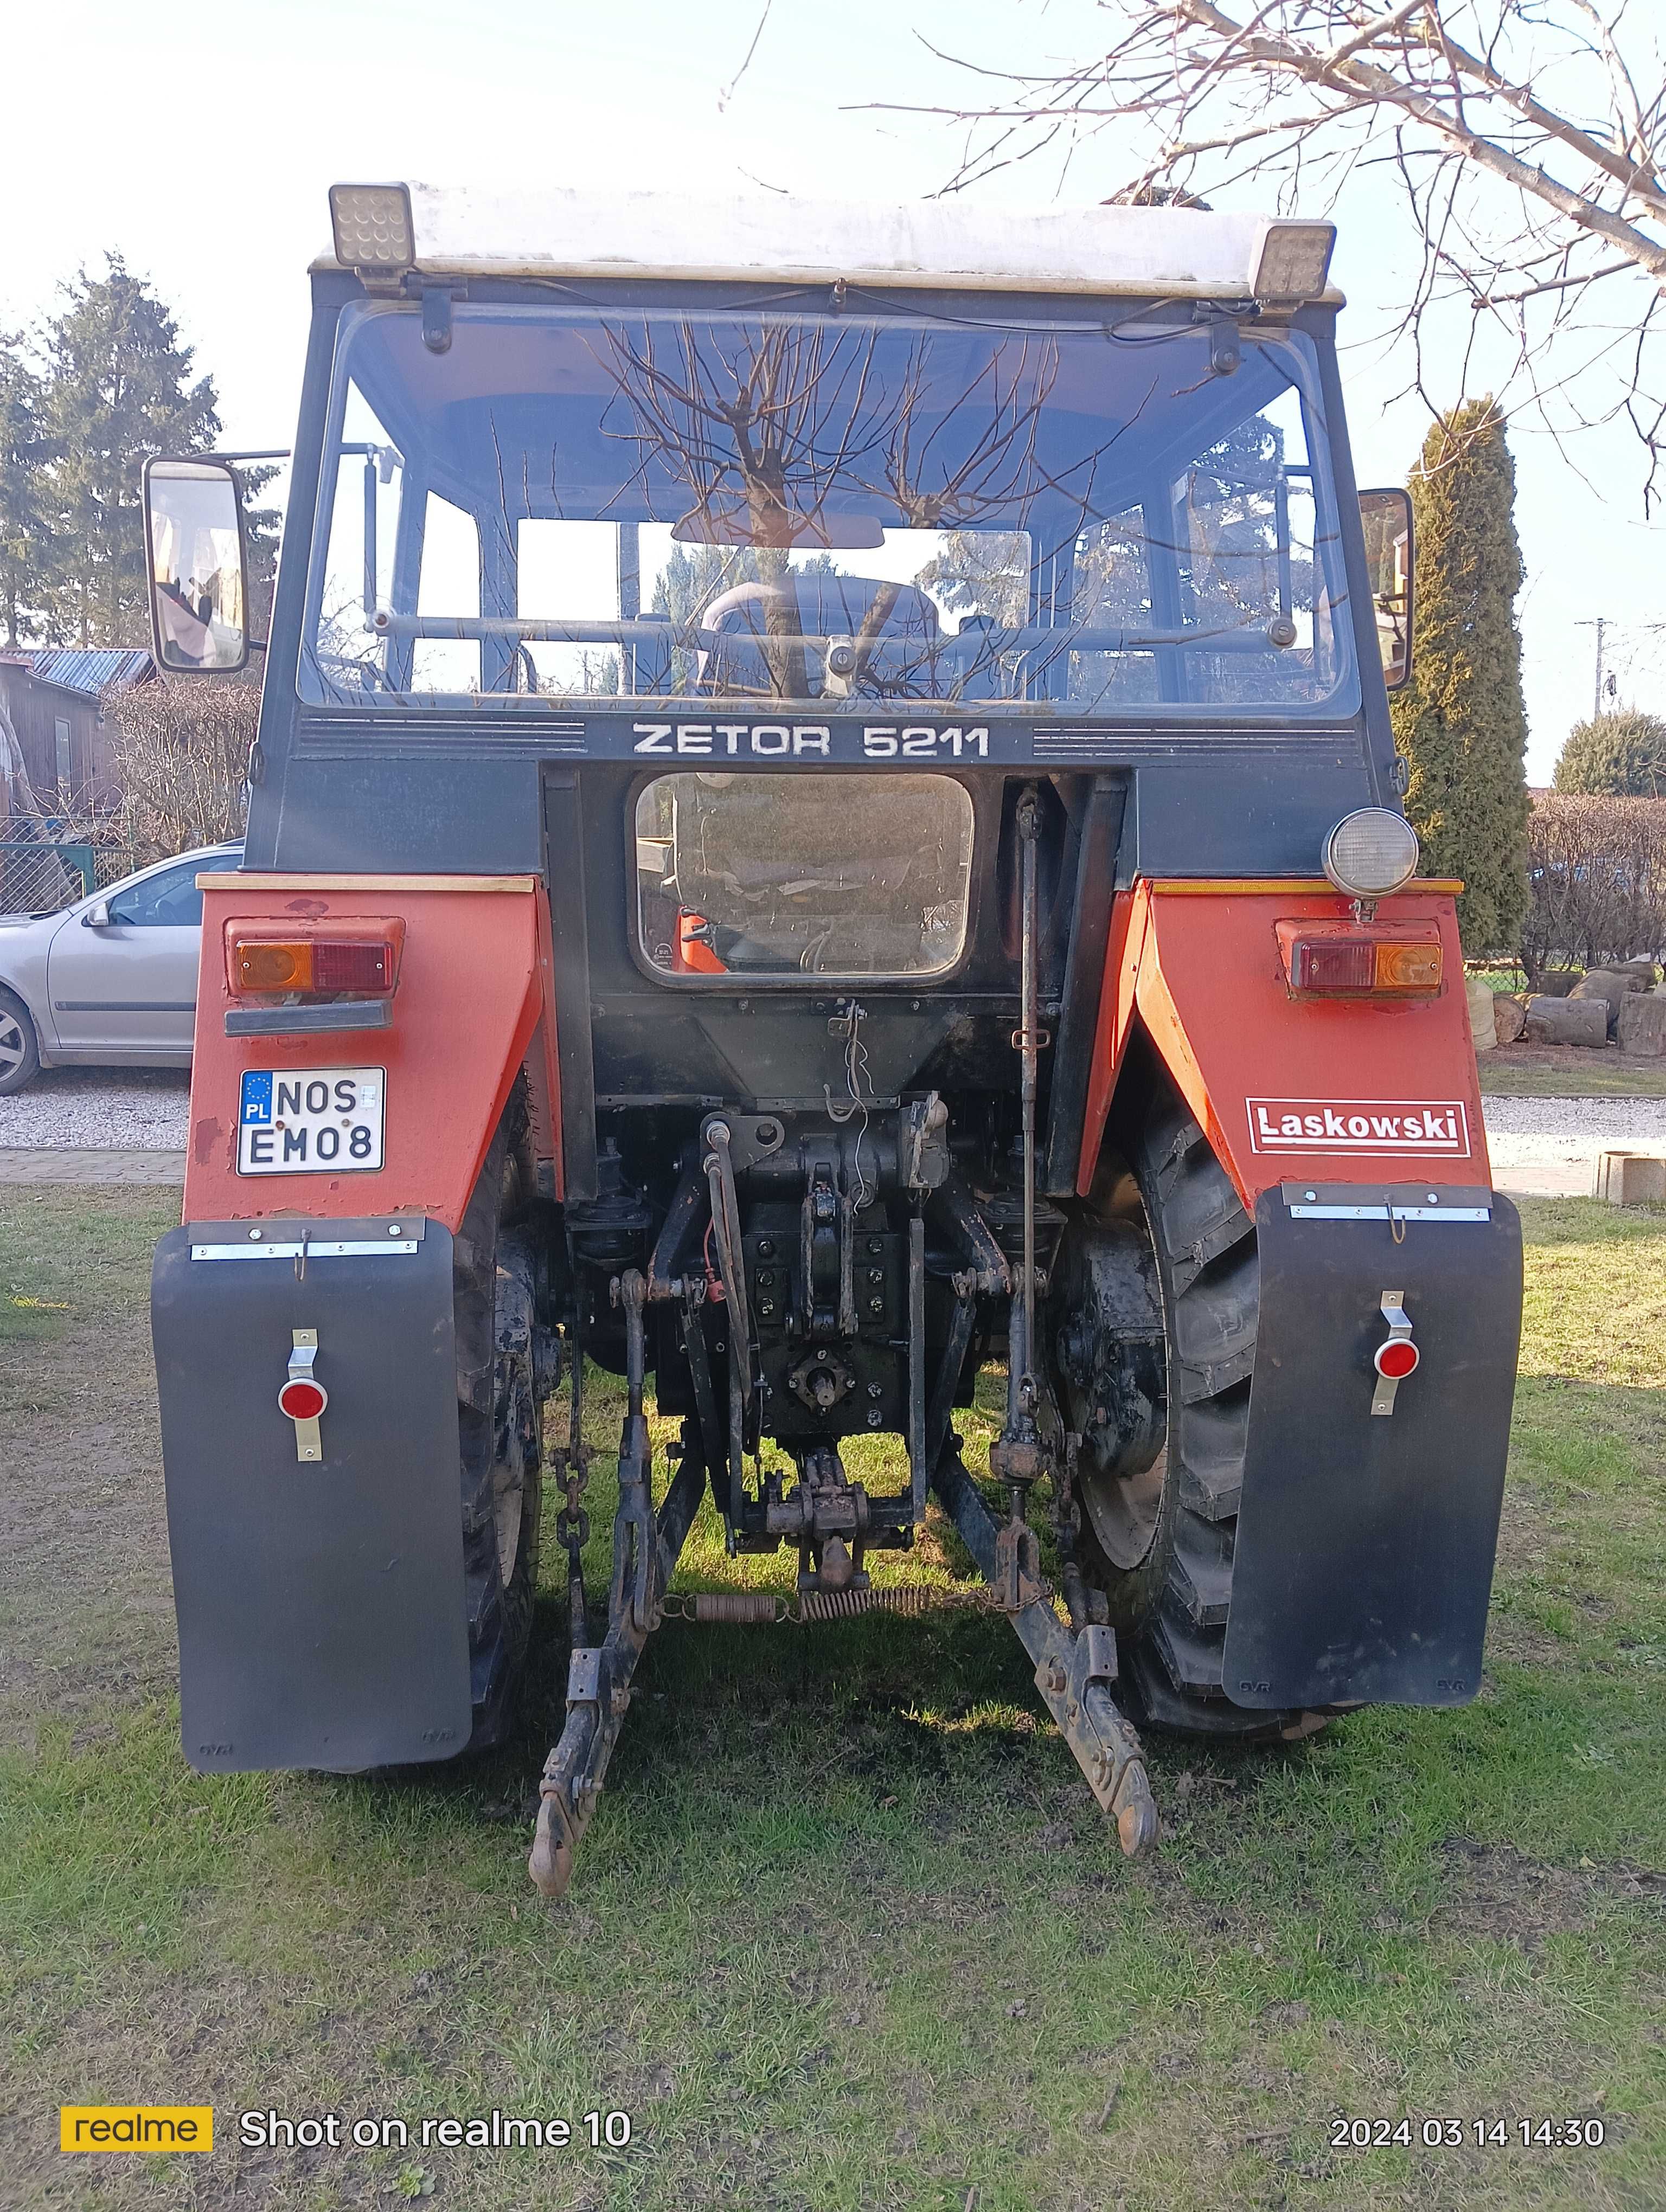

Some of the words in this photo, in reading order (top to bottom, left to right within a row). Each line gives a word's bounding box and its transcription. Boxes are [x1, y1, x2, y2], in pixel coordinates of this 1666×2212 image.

[632, 723, 830, 755] ZETOR
[863, 726, 989, 757] 5211
[246, 1103, 269, 1120] PL
[277, 1079, 356, 1115] NOS
[1257, 1107, 1459, 1139] Laskowski
